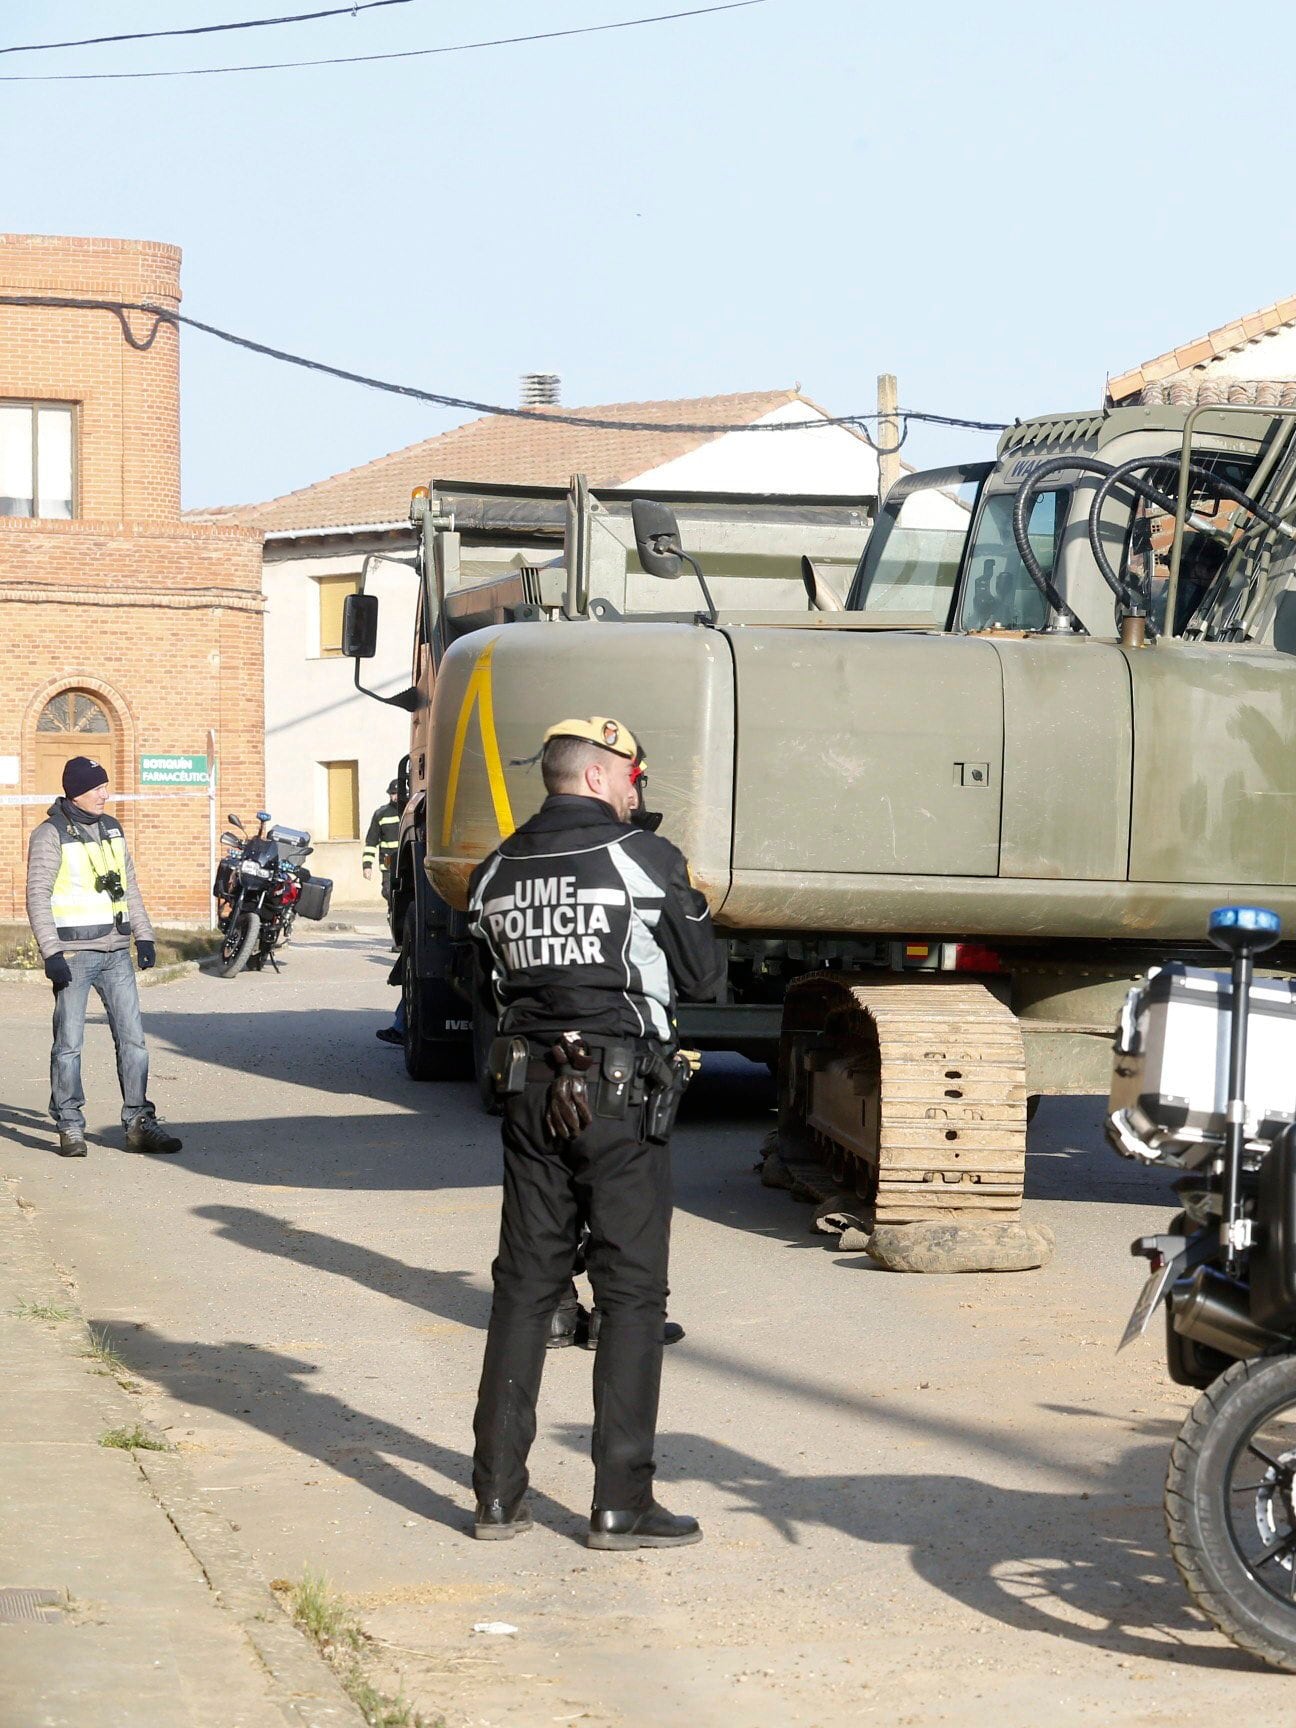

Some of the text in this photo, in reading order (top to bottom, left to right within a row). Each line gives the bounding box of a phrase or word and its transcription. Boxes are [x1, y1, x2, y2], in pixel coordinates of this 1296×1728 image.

[142, 770, 210, 782] FARMACÉUTIC
[143, 757, 193, 769] BOTIQUÍN
[514, 876, 576, 908] UME
[488, 905, 611, 942] POLICIA
[501, 935, 605, 970] MILITAR
